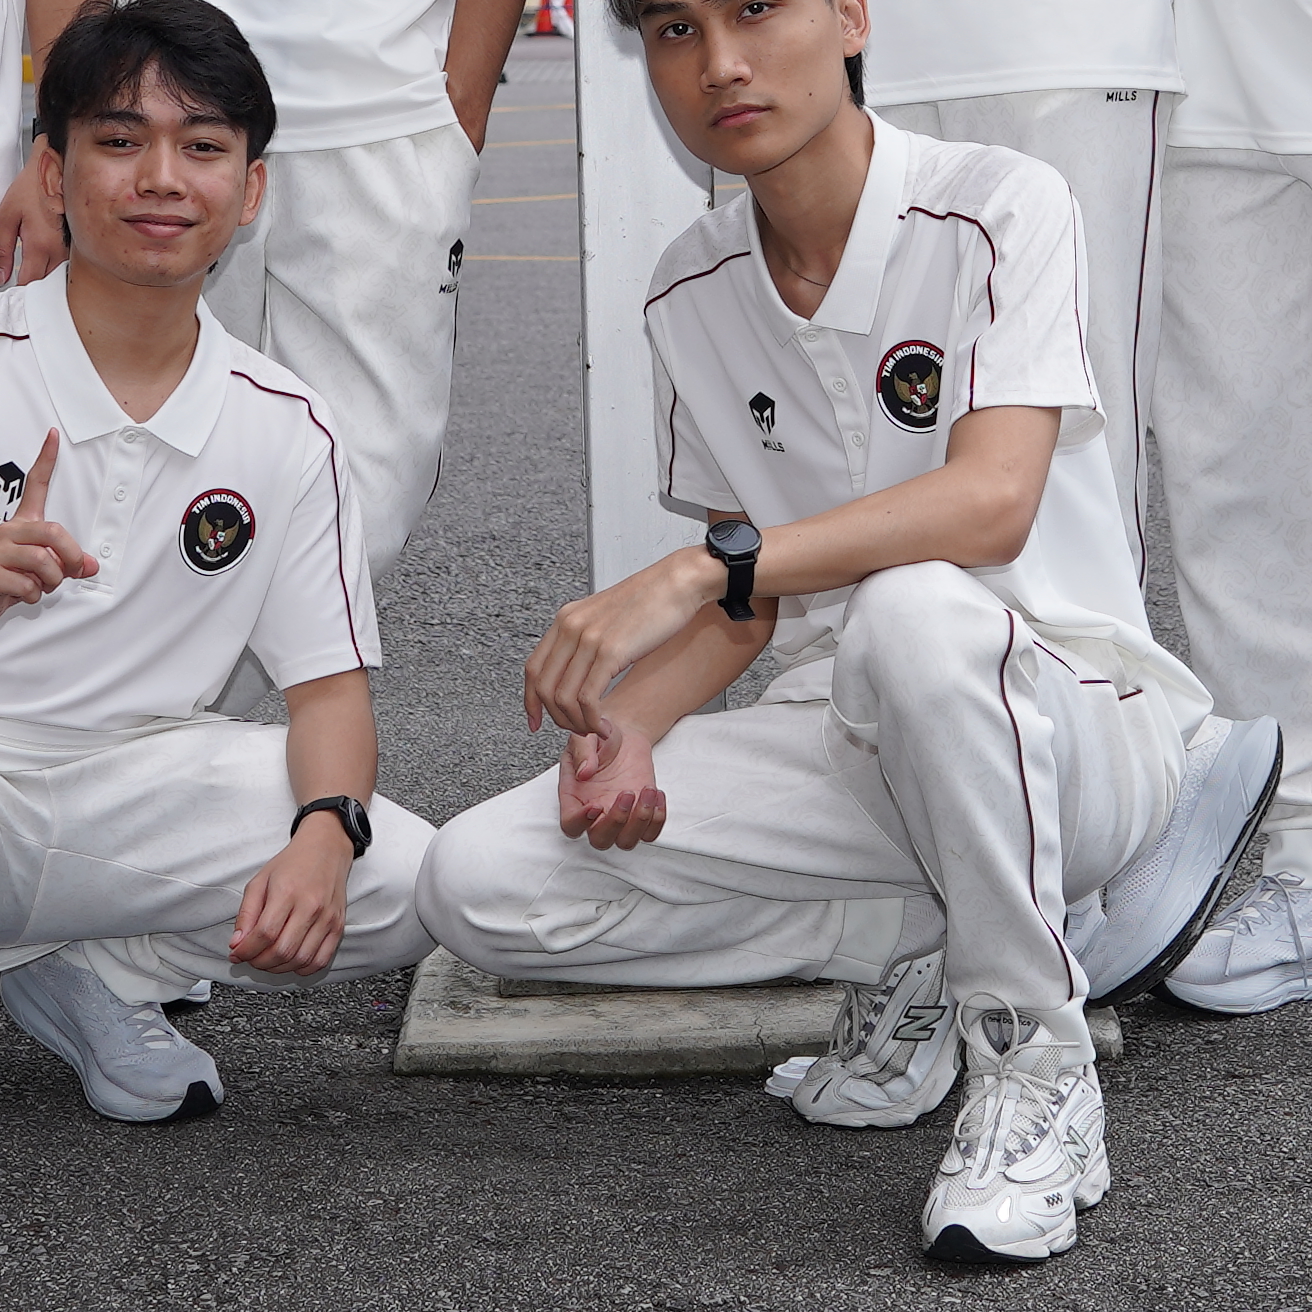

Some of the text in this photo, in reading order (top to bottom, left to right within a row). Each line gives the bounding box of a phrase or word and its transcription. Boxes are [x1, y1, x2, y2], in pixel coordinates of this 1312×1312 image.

[1105, 90, 1138, 103] MILLS
[881, 357, 896, 378] TIM
[191, 493, 251, 525] TIM INDONESIA
